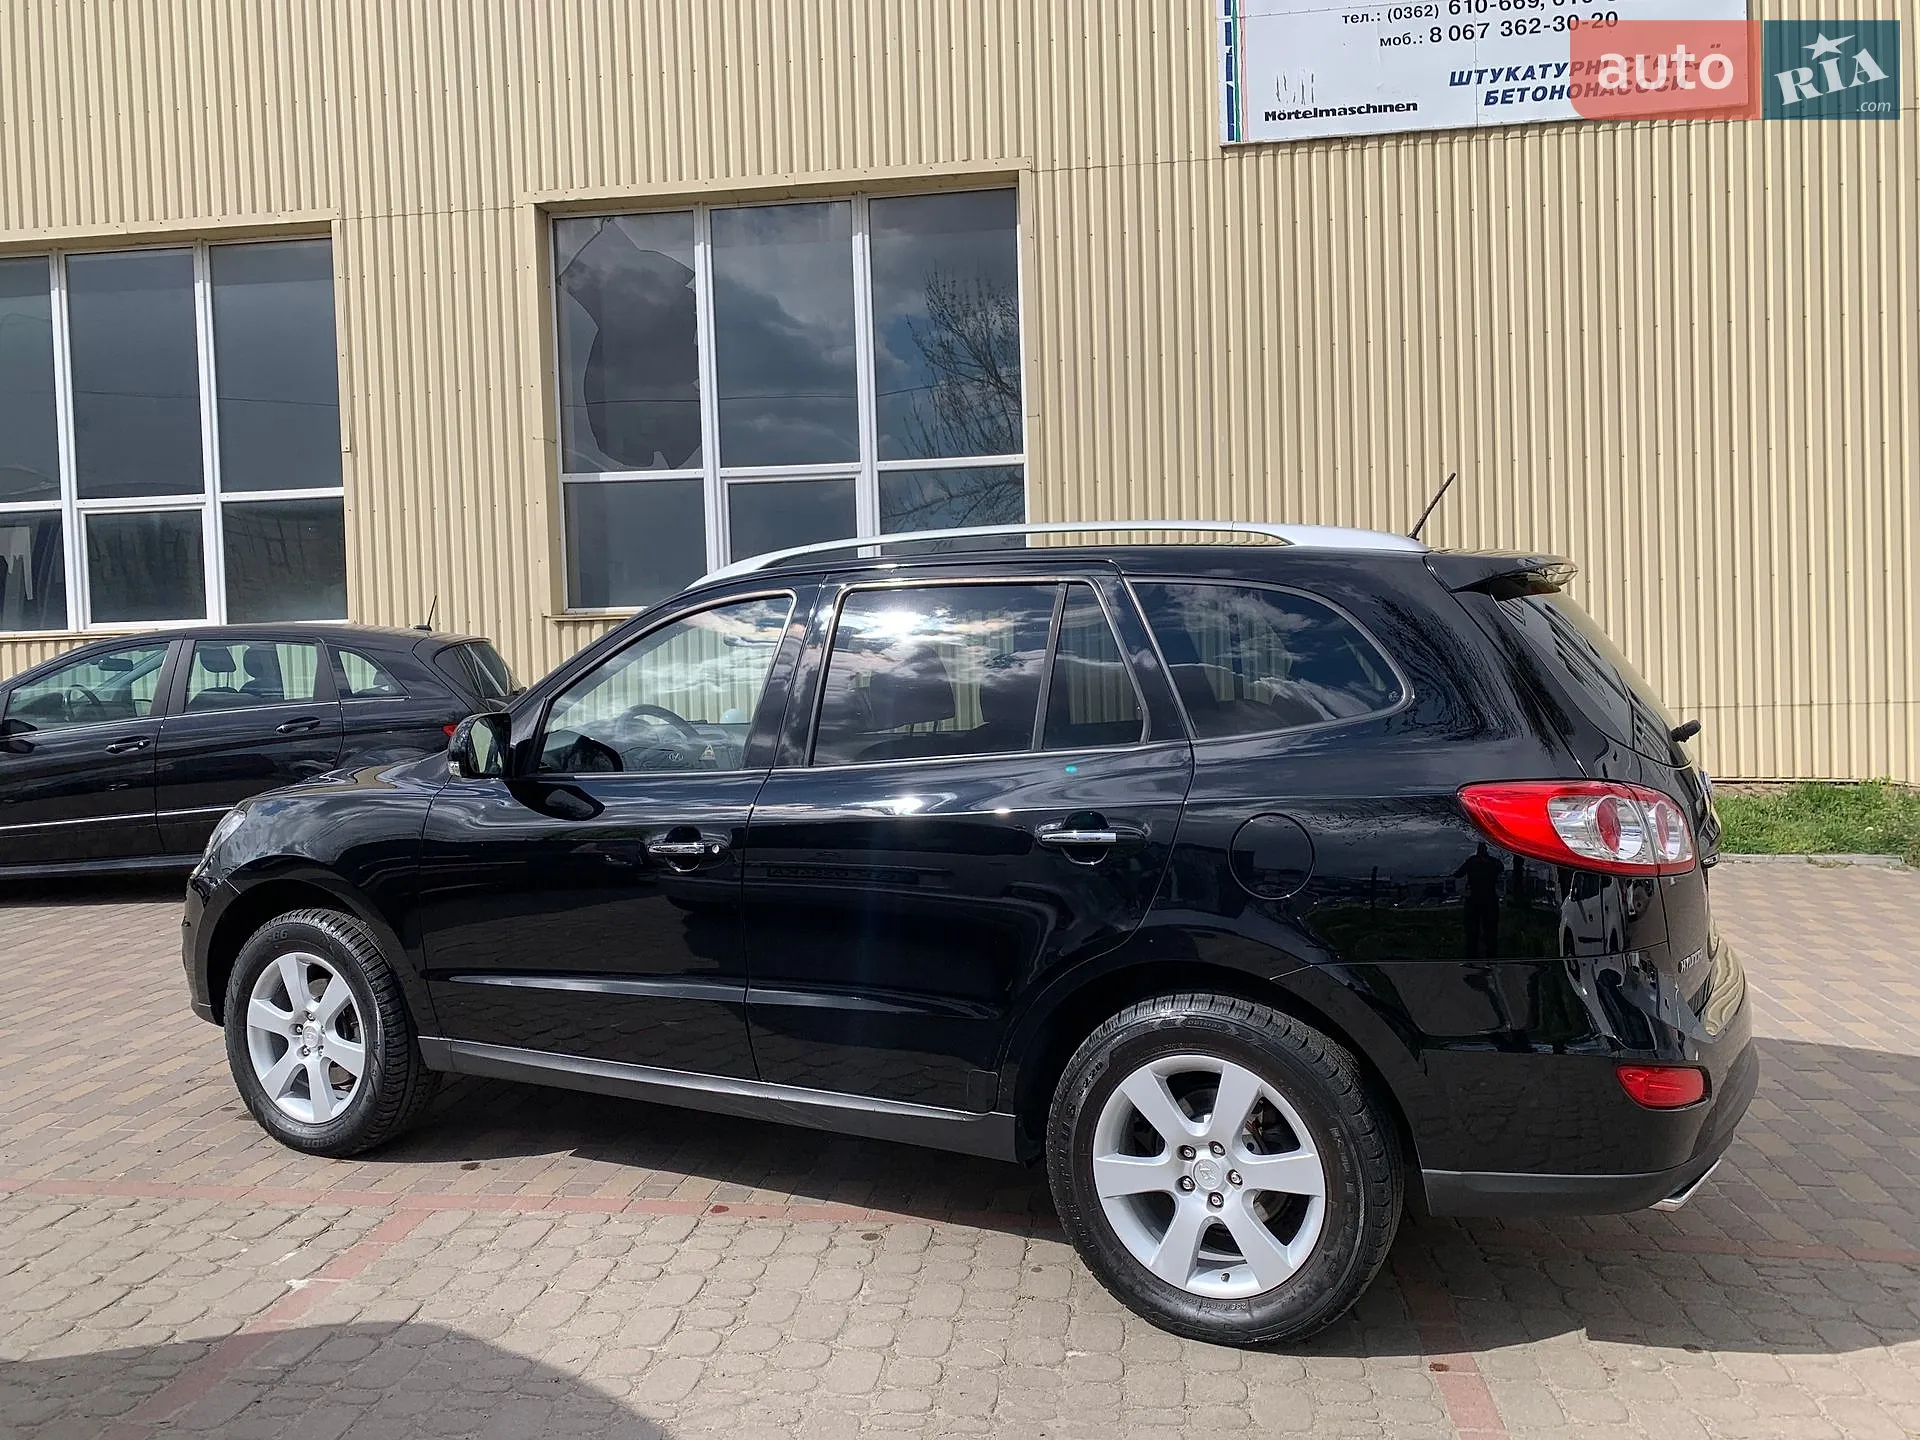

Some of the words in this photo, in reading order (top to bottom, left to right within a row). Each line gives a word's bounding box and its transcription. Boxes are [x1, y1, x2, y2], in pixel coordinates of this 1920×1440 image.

[1342, 12, 1381, 24] тел.:
[1387, 4, 1439, 23] (0362)
[1379, 32, 1423, 47] моб.:
[1429, 26, 1442, 43] 8
[1448, 22, 1490, 42] 067
[1500, 11, 1618, 37] 362-30-20
[1264, 102, 1418, 122] Mörtelmaschinen
